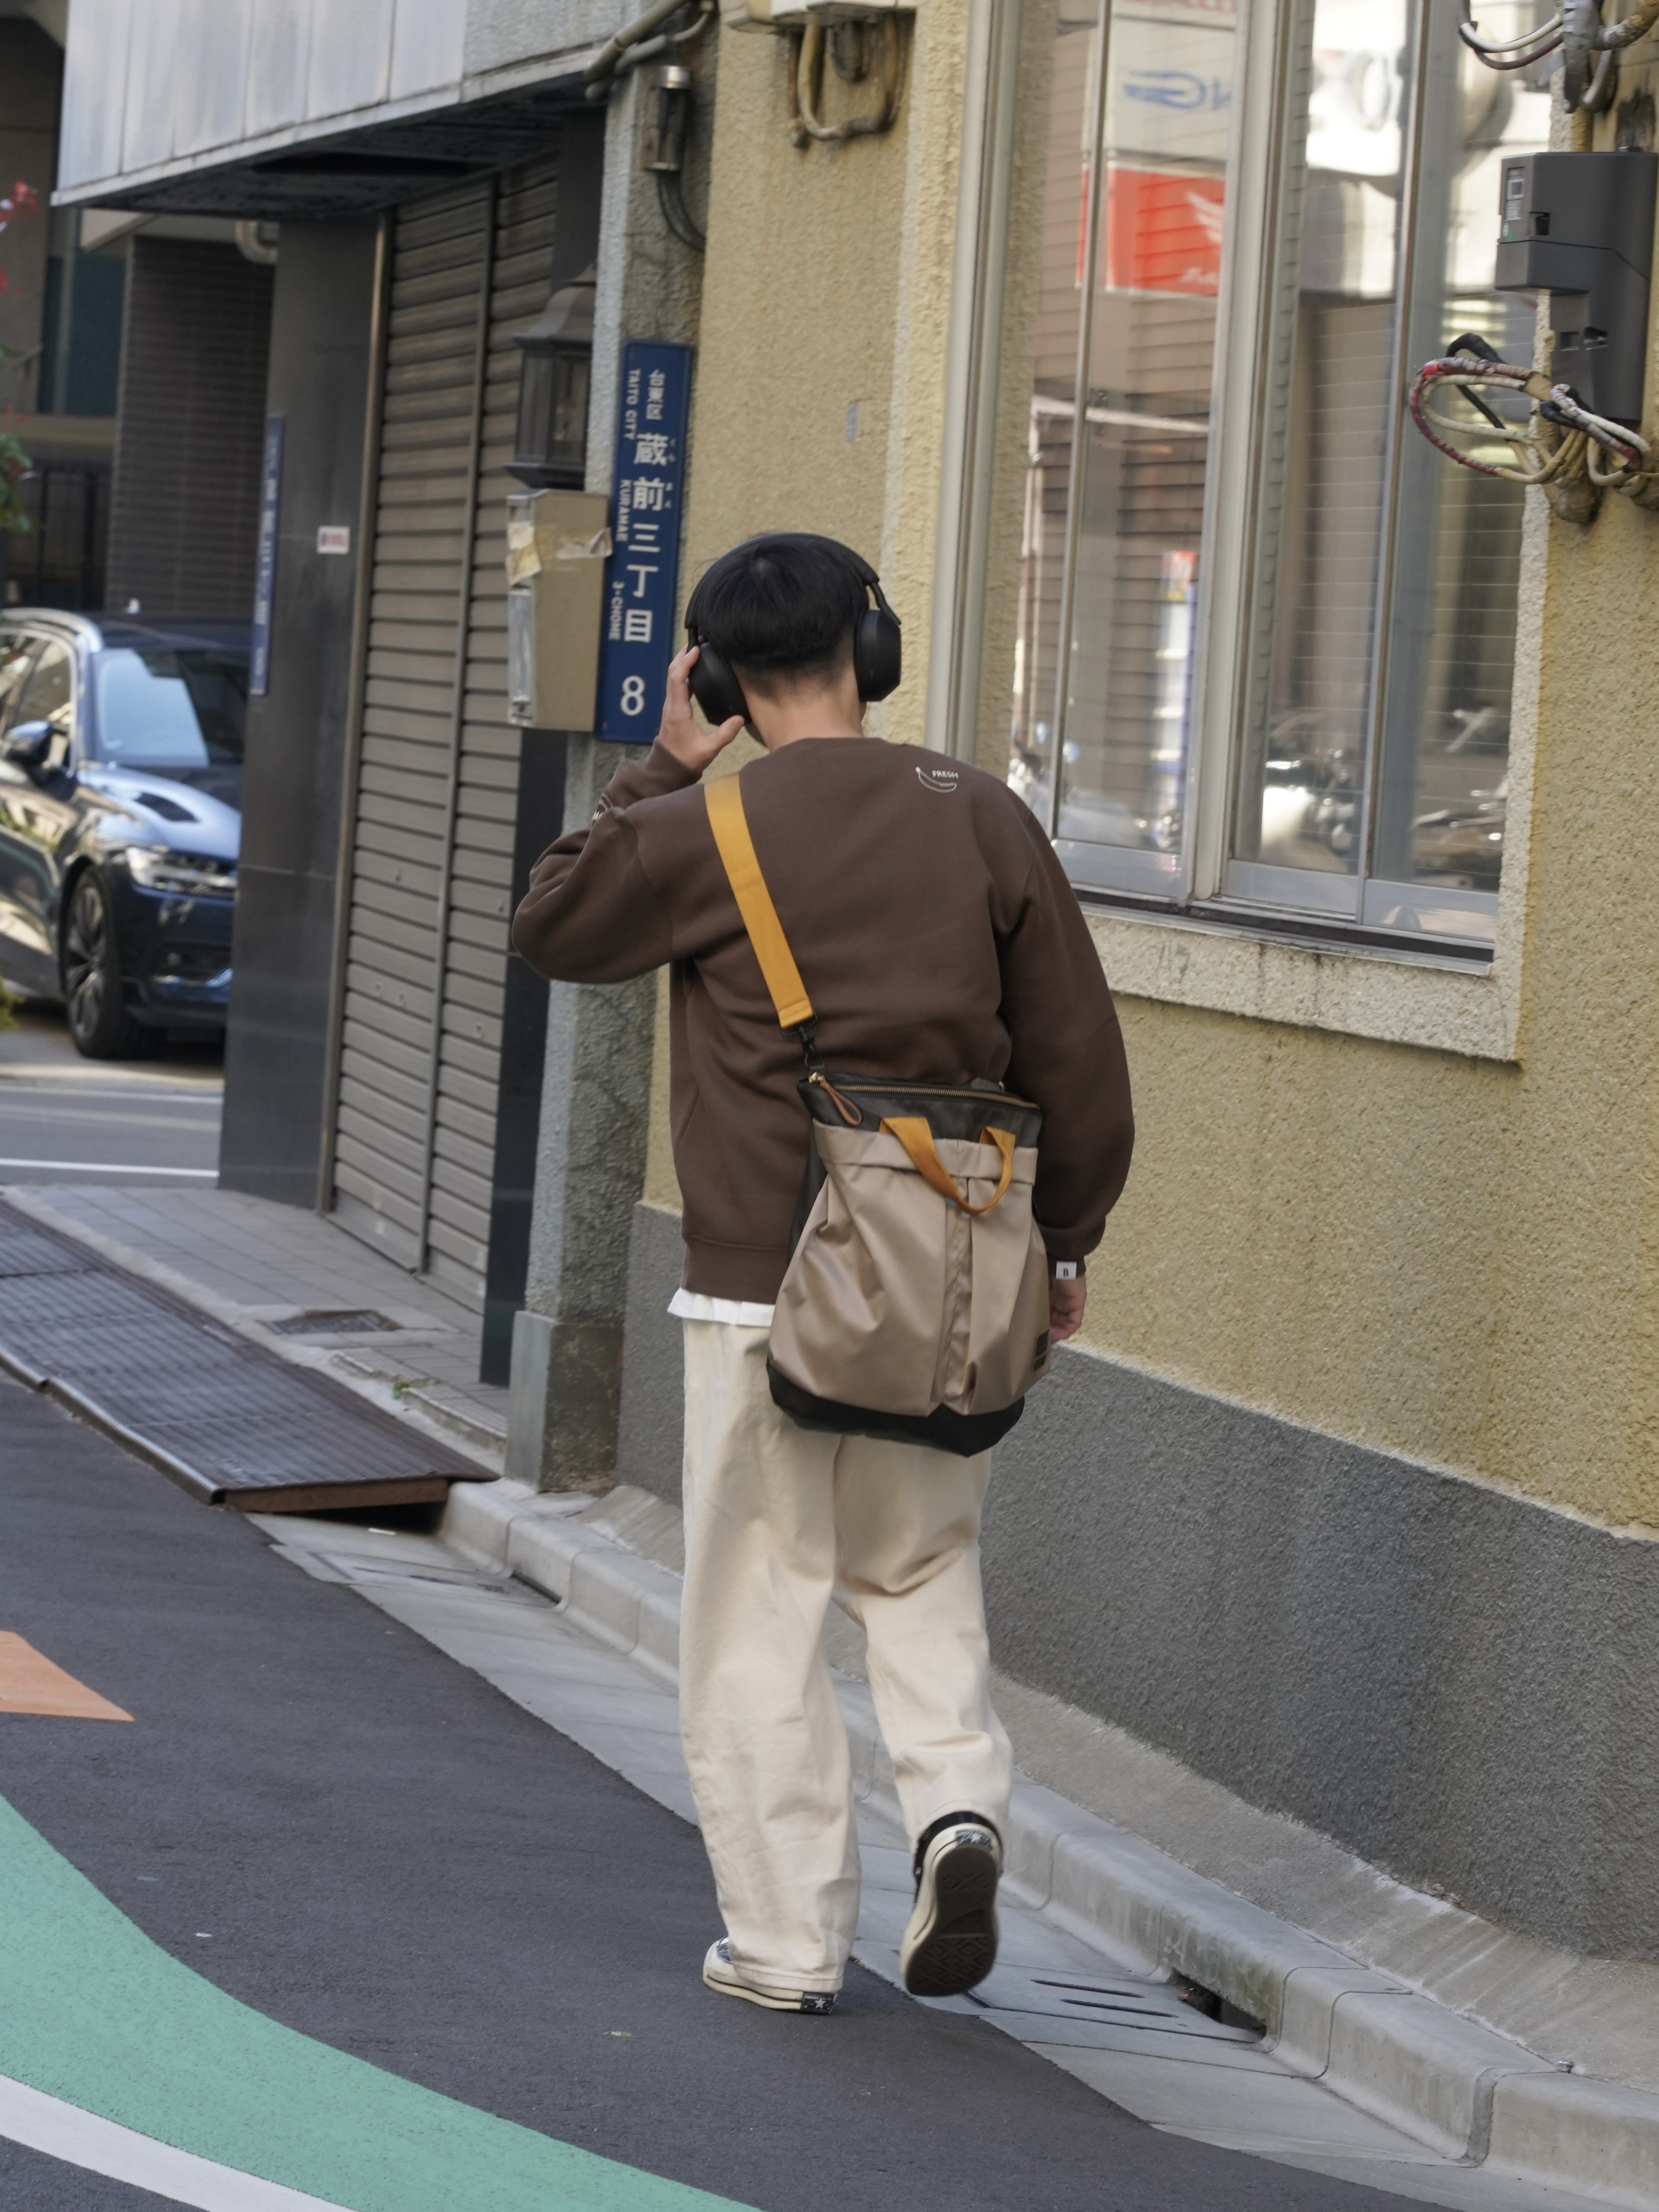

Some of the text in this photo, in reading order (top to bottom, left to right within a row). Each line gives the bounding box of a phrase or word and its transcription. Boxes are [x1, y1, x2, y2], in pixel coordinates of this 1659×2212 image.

[623, 368, 641, 441] TAITO CITY
[646, 369, 666, 420] 台東区
[615, 479, 632, 541] KURAMAE
[608, 580, 625, 640] 3-CHOME
[620, 675, 645, 716] 8
[932, 770, 959, 779] FRESH
